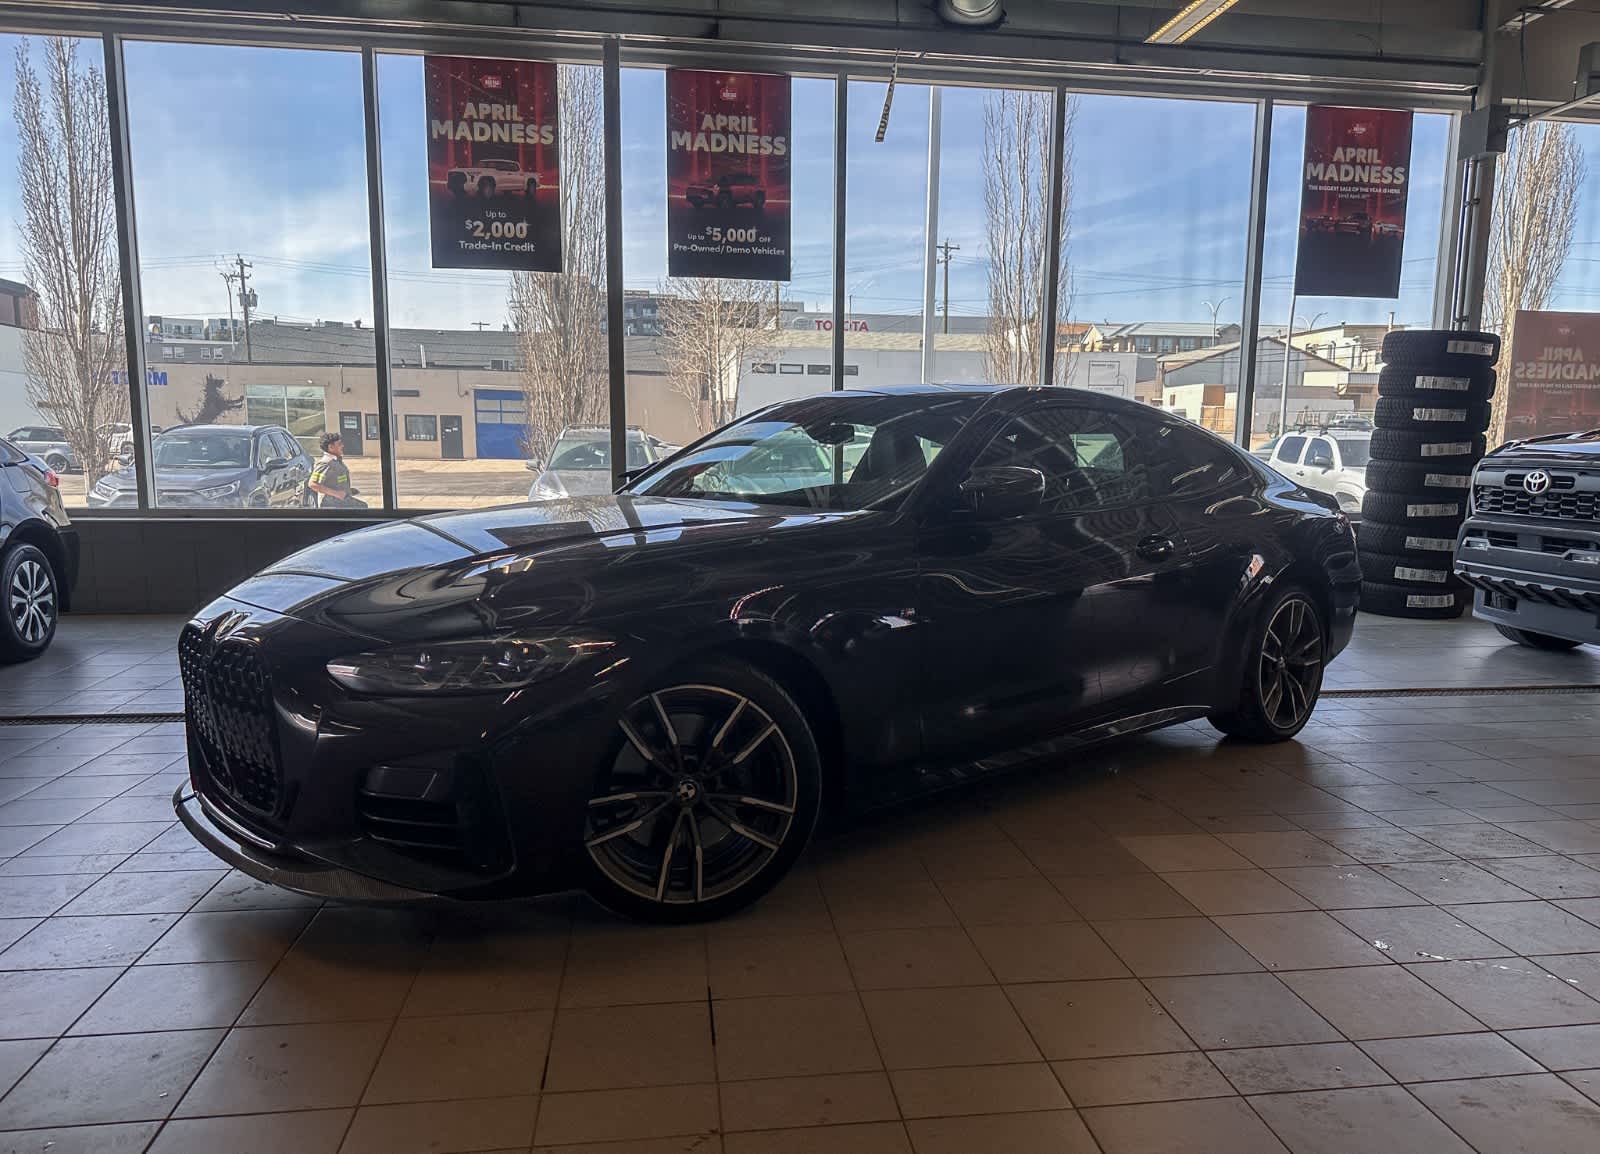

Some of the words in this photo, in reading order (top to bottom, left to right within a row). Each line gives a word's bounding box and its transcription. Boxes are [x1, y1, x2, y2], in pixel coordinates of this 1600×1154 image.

[463, 102, 524, 122] APRIL
[431, 119, 554, 145] MADNESS
[701, 113, 758, 133] APRIL
[671, 130, 787, 155] MADNESS
[1332, 146, 1382, 164] APRIL
[1306, 162, 1405, 185] MADNESS
[485, 210, 497, 219] Up
[464, 219, 529, 240] $2,000
[687, 233, 697, 241] Up
[705, 226, 758, 244] $5,000
[458, 240, 502, 251] Trade-In
[503, 242, 536, 252] Credit
[726, 246, 751, 254] Demo
[752, 247, 785, 256] Vehicles
